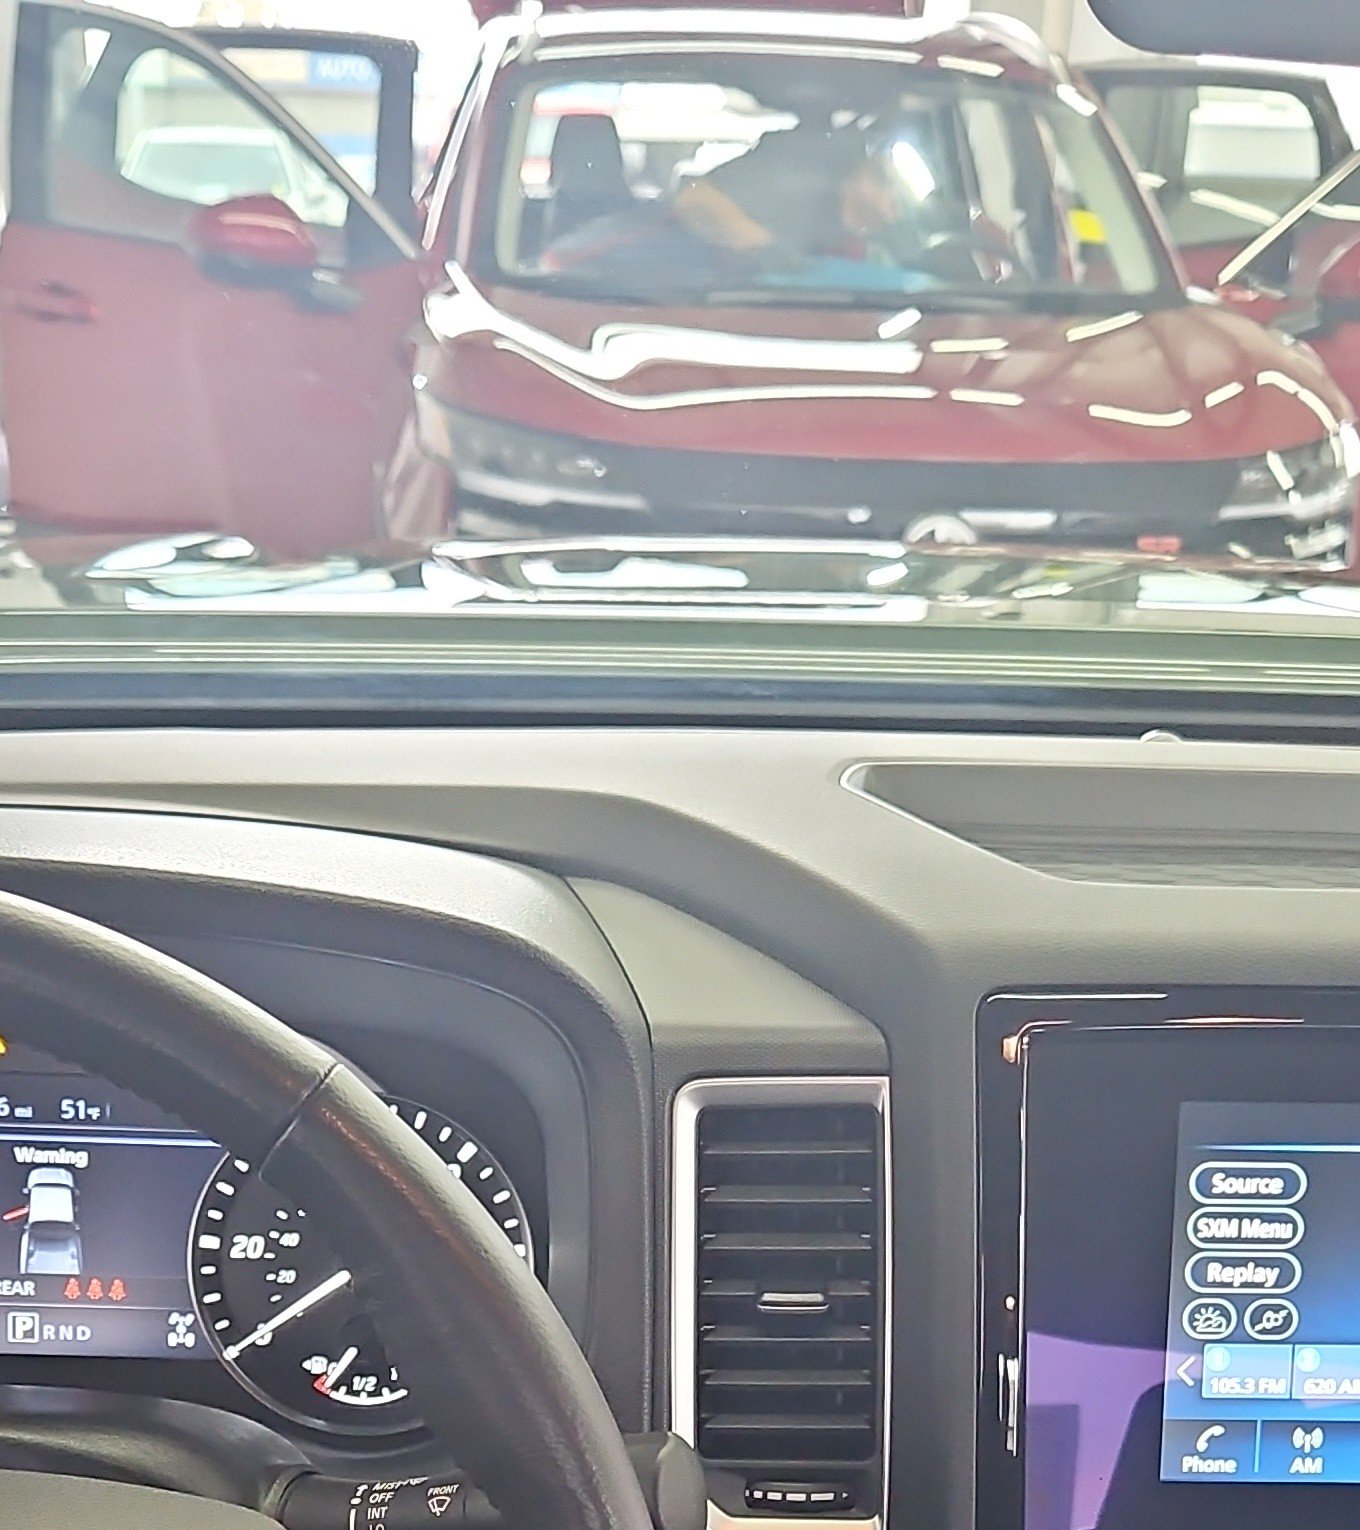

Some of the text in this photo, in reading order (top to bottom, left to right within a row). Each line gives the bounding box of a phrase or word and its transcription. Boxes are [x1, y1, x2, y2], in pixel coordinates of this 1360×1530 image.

[13, 1146, 89, 1169] Warning
[1211, 1172, 1285, 1195] Source
[1196, 1217, 1294, 1239] SXM Menu
[229, 1234, 266, 1259] 20
[1206, 1261, 1281, 1288] Replay
[14, 1315, 91, 1341] P R N D
[352, 1375, 378, 1392] 1/2
[1209, 1377, 1288, 1395] 105.3 FM
[1181, 1455, 1238, 1474] Phone
[1289, 1456, 1323, 1474] AM
[369, 1491, 395, 1504] OFF
[427, 1484, 460, 1496] FRONT
[367, 1507, 389, 1520] INT
